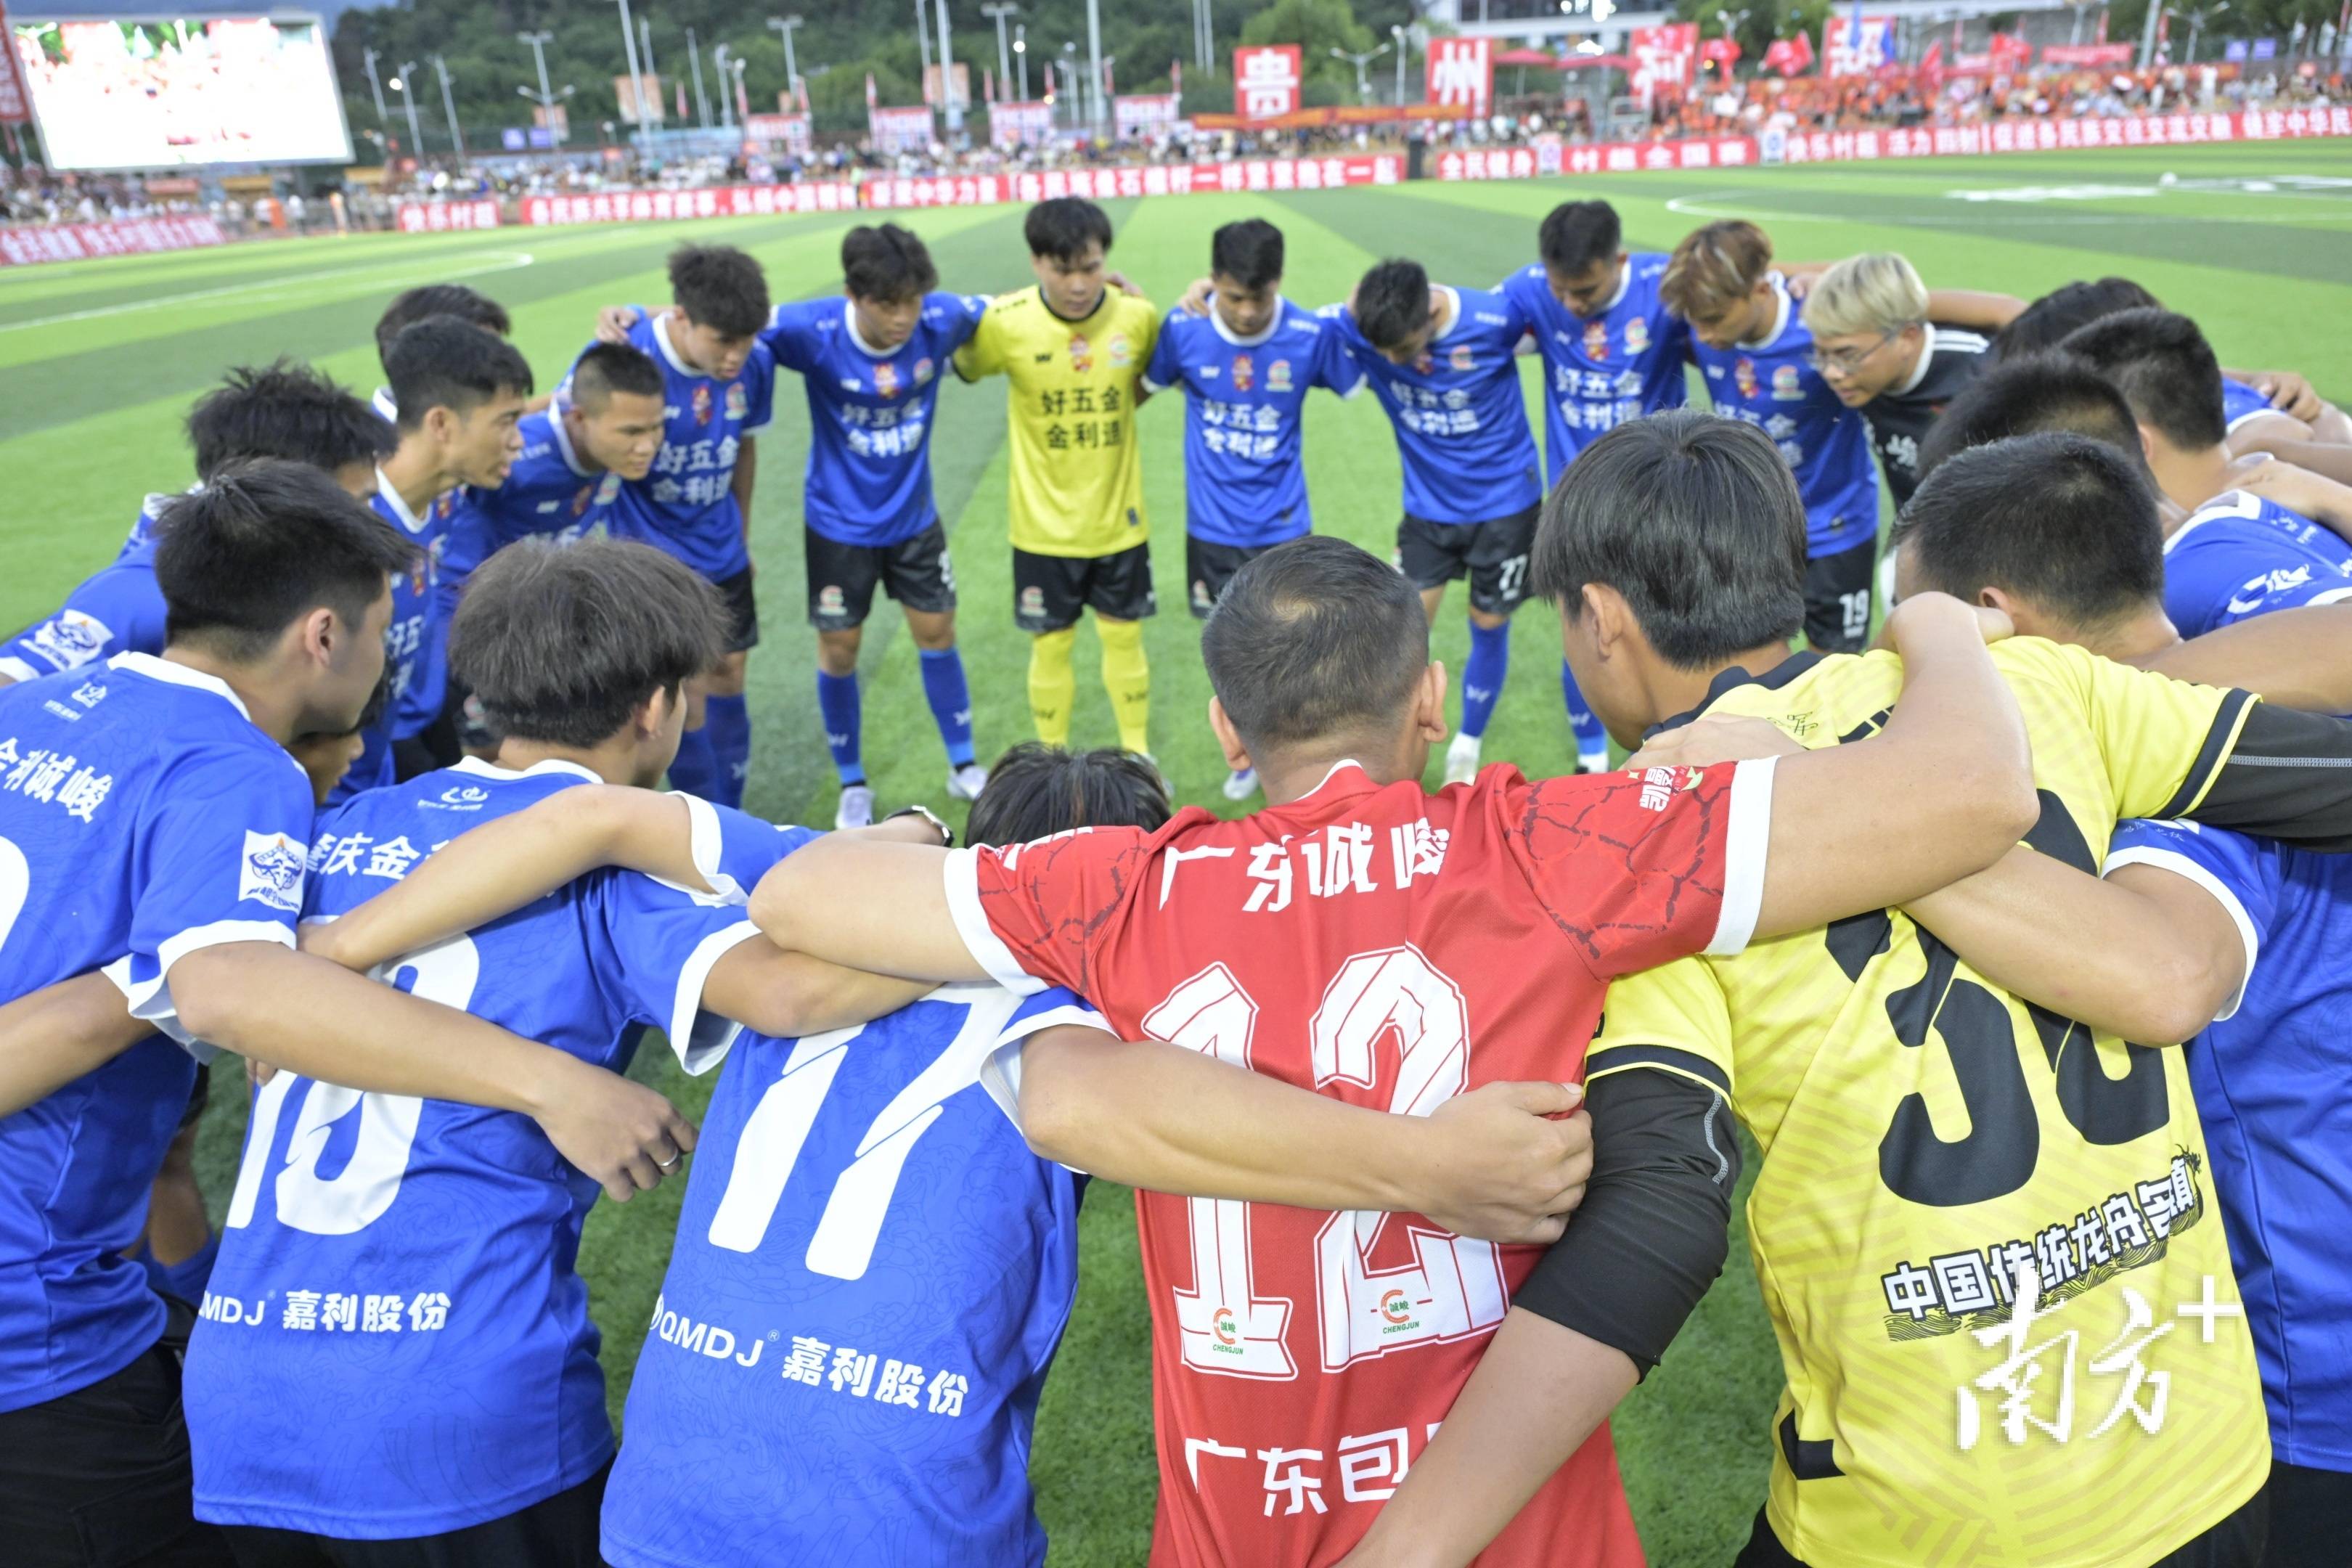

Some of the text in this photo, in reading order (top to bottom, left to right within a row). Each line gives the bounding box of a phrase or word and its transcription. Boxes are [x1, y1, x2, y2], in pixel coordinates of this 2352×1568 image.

[1238, 48, 1299, 121] 贵
[1431, 39, 1488, 117] 州
[1041, 385, 1121, 417] 好五金
[1839, 589, 1869, 625] 19
[1140, 940, 1511, 1381] 12
[282, 1289, 452, 1332] 嘉利股份
[1383, 1320, 1420, 1334] CHENGJUN
[1212, 1344, 1244, 1355] CHENGJUN
[782, 1335, 968, 1418] 嘉利股份
[1185, 1421, 1443, 1518] 广东包
